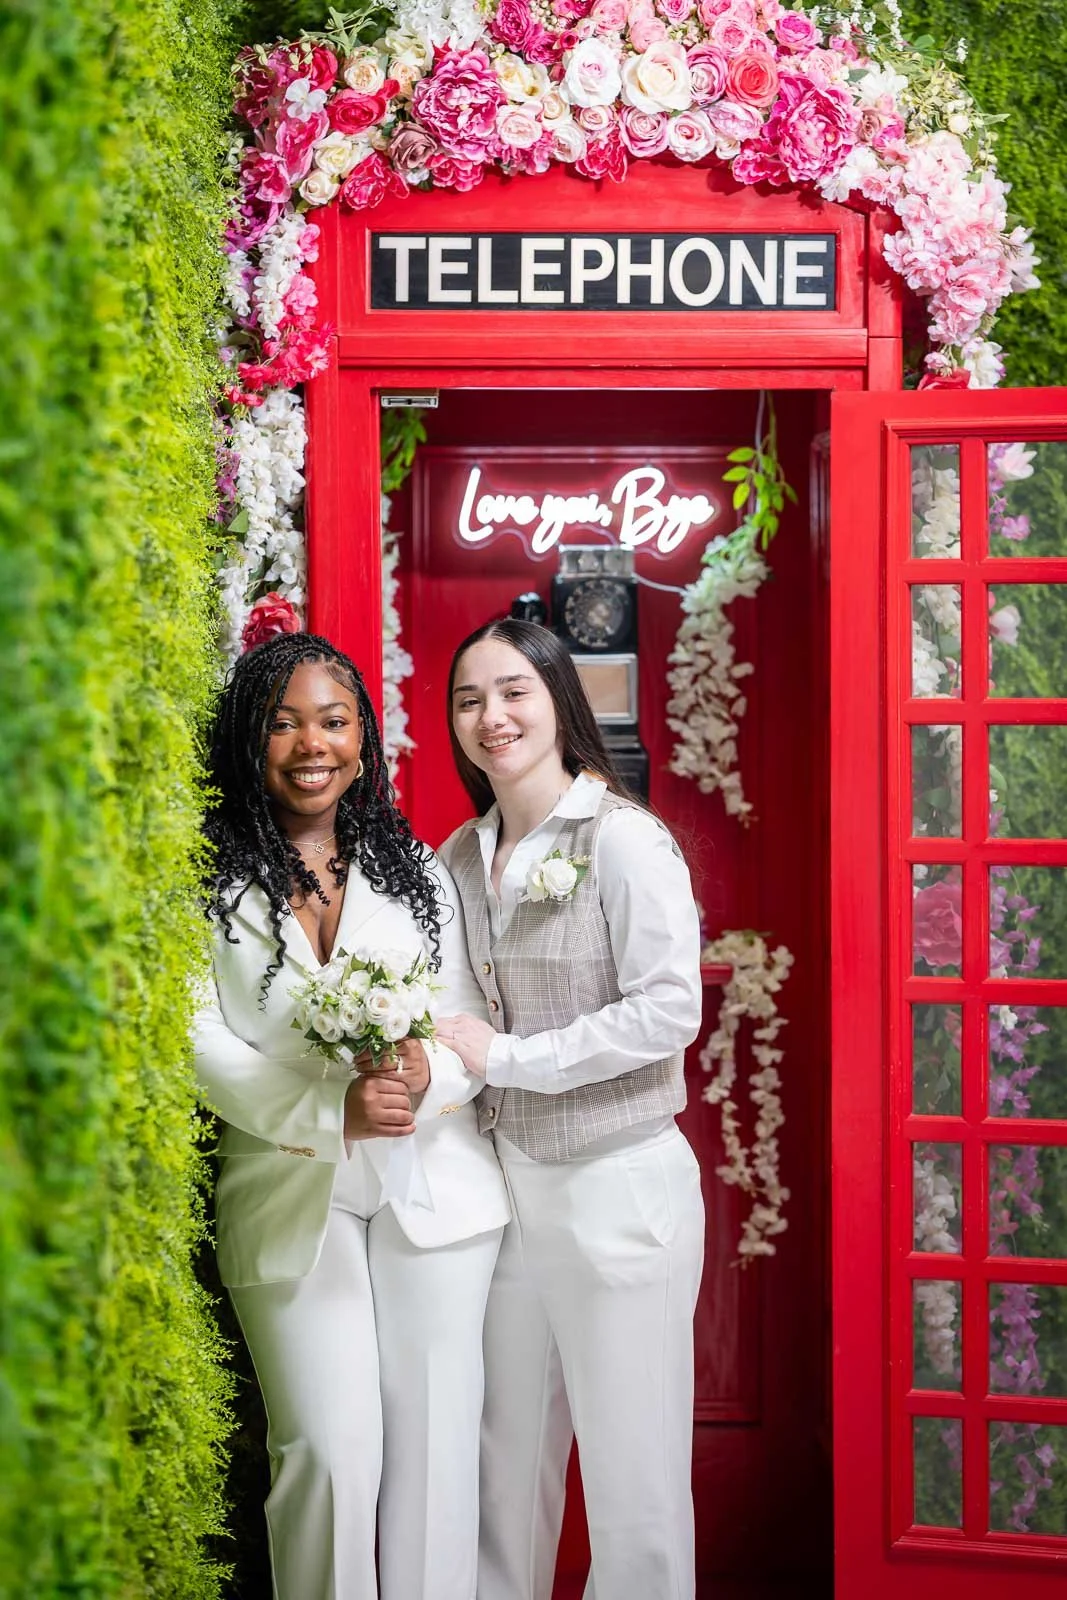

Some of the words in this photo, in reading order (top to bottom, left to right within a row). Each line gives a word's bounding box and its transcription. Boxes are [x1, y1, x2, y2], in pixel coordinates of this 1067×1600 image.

[378, 236, 828, 307] TELEPHONE
[458, 466, 539, 542] Love
[611, 466, 715, 554] Bye
